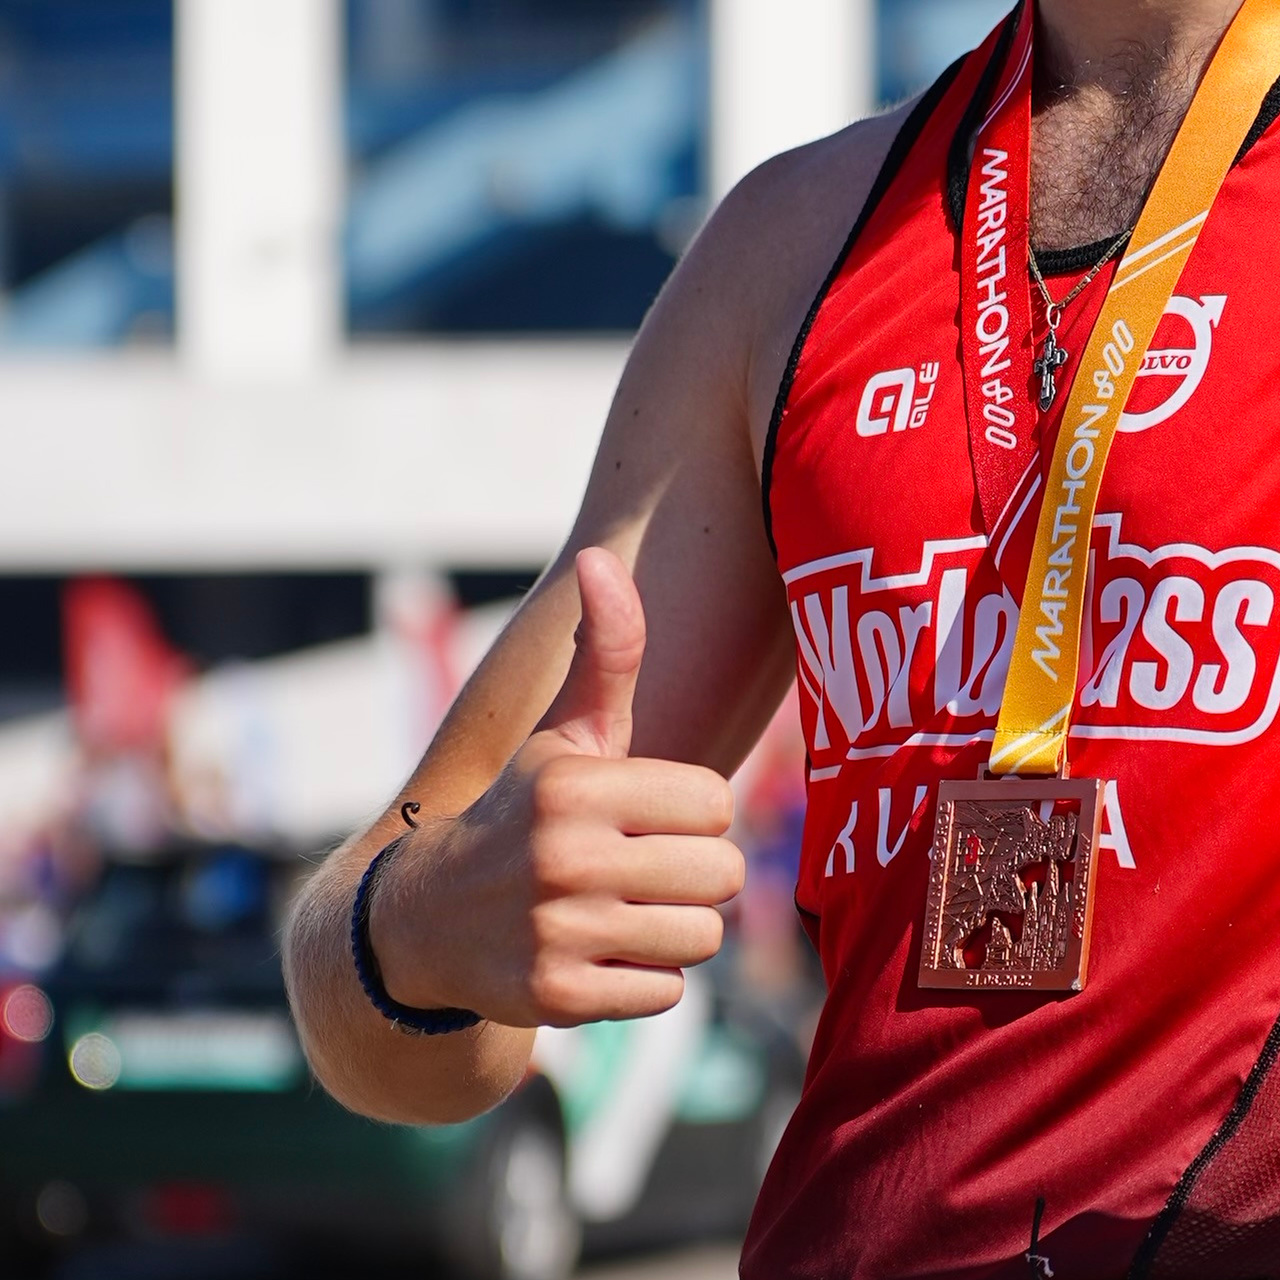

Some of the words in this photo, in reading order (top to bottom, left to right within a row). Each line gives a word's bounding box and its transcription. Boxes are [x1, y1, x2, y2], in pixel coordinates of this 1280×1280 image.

[975, 148, 1011, 378] MARATHON
[1138, 355, 1192, 370] LVO
[1030, 405, 1109, 683] MARATHON
